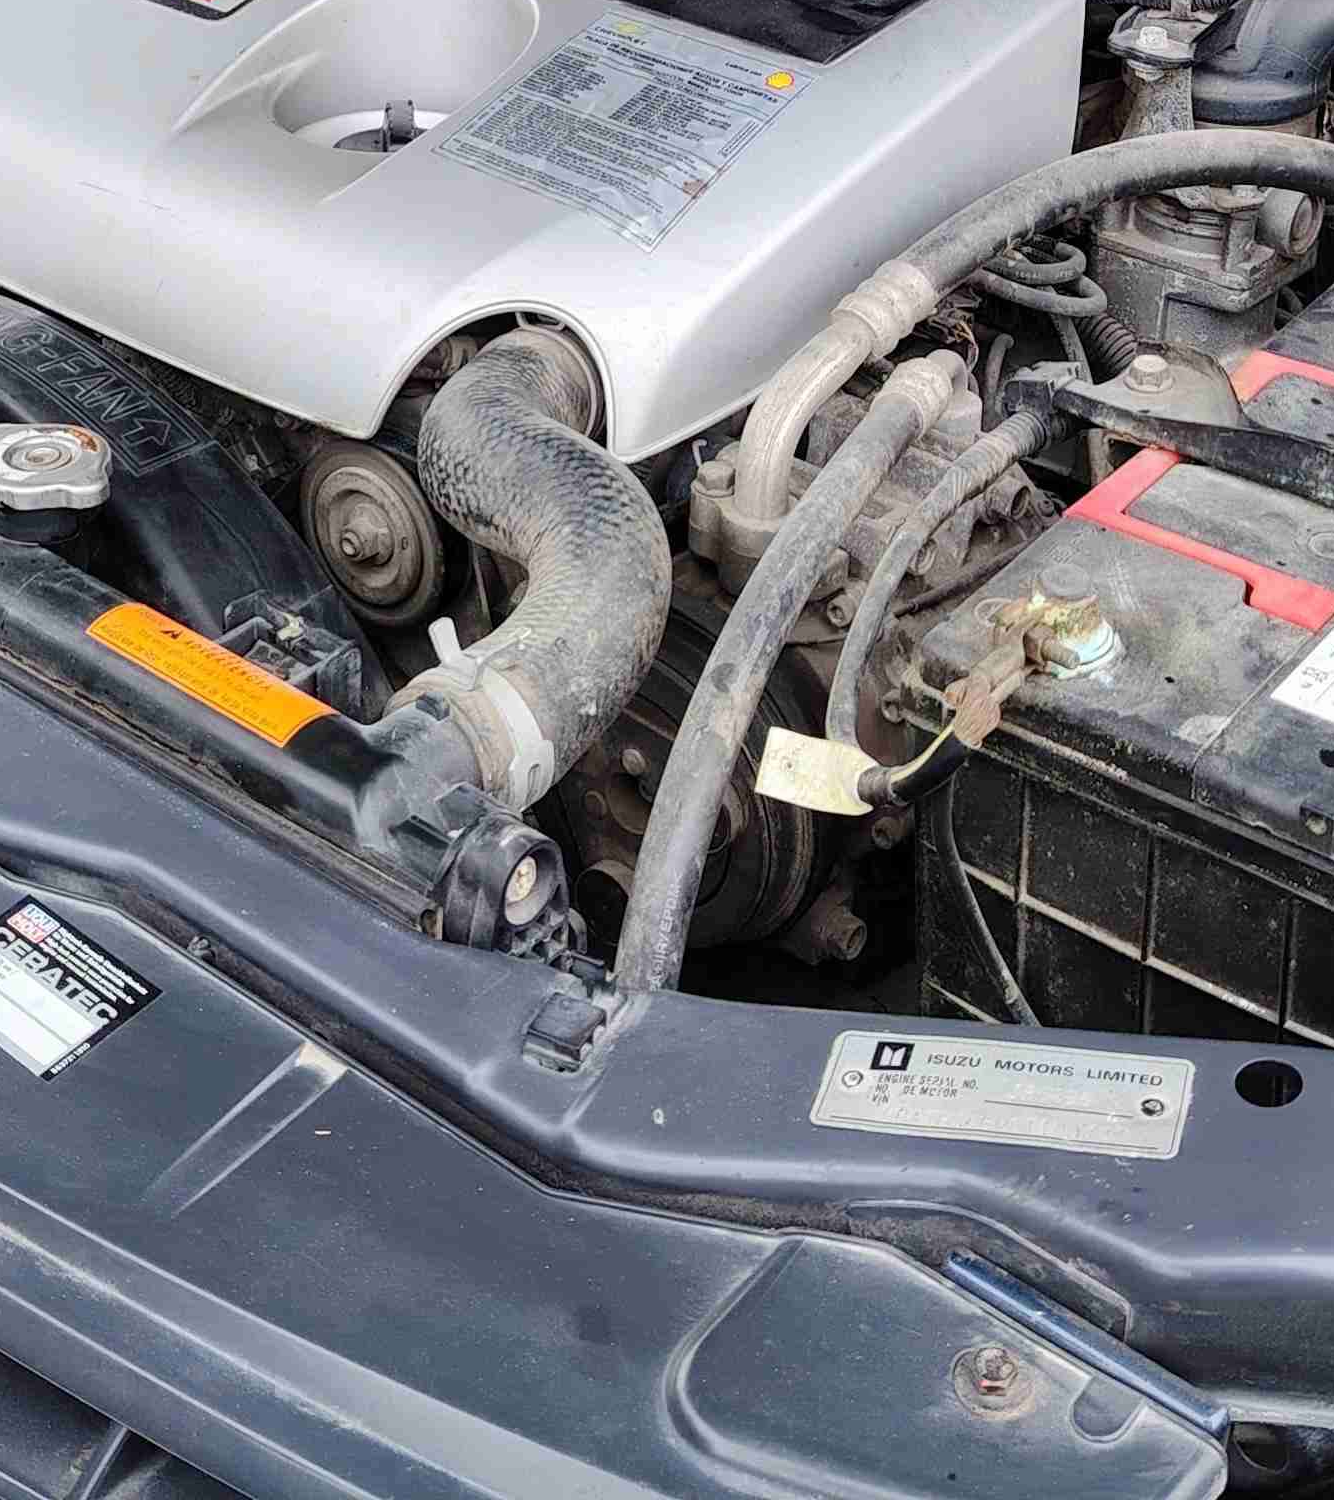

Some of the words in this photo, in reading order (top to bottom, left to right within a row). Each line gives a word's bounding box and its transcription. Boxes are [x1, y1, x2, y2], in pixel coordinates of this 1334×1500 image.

[927, 1053, 982, 1068] ISUZU
[994, 1060, 1075, 1077] MOTORS
[1086, 1069, 1163, 1087] LIMITED
